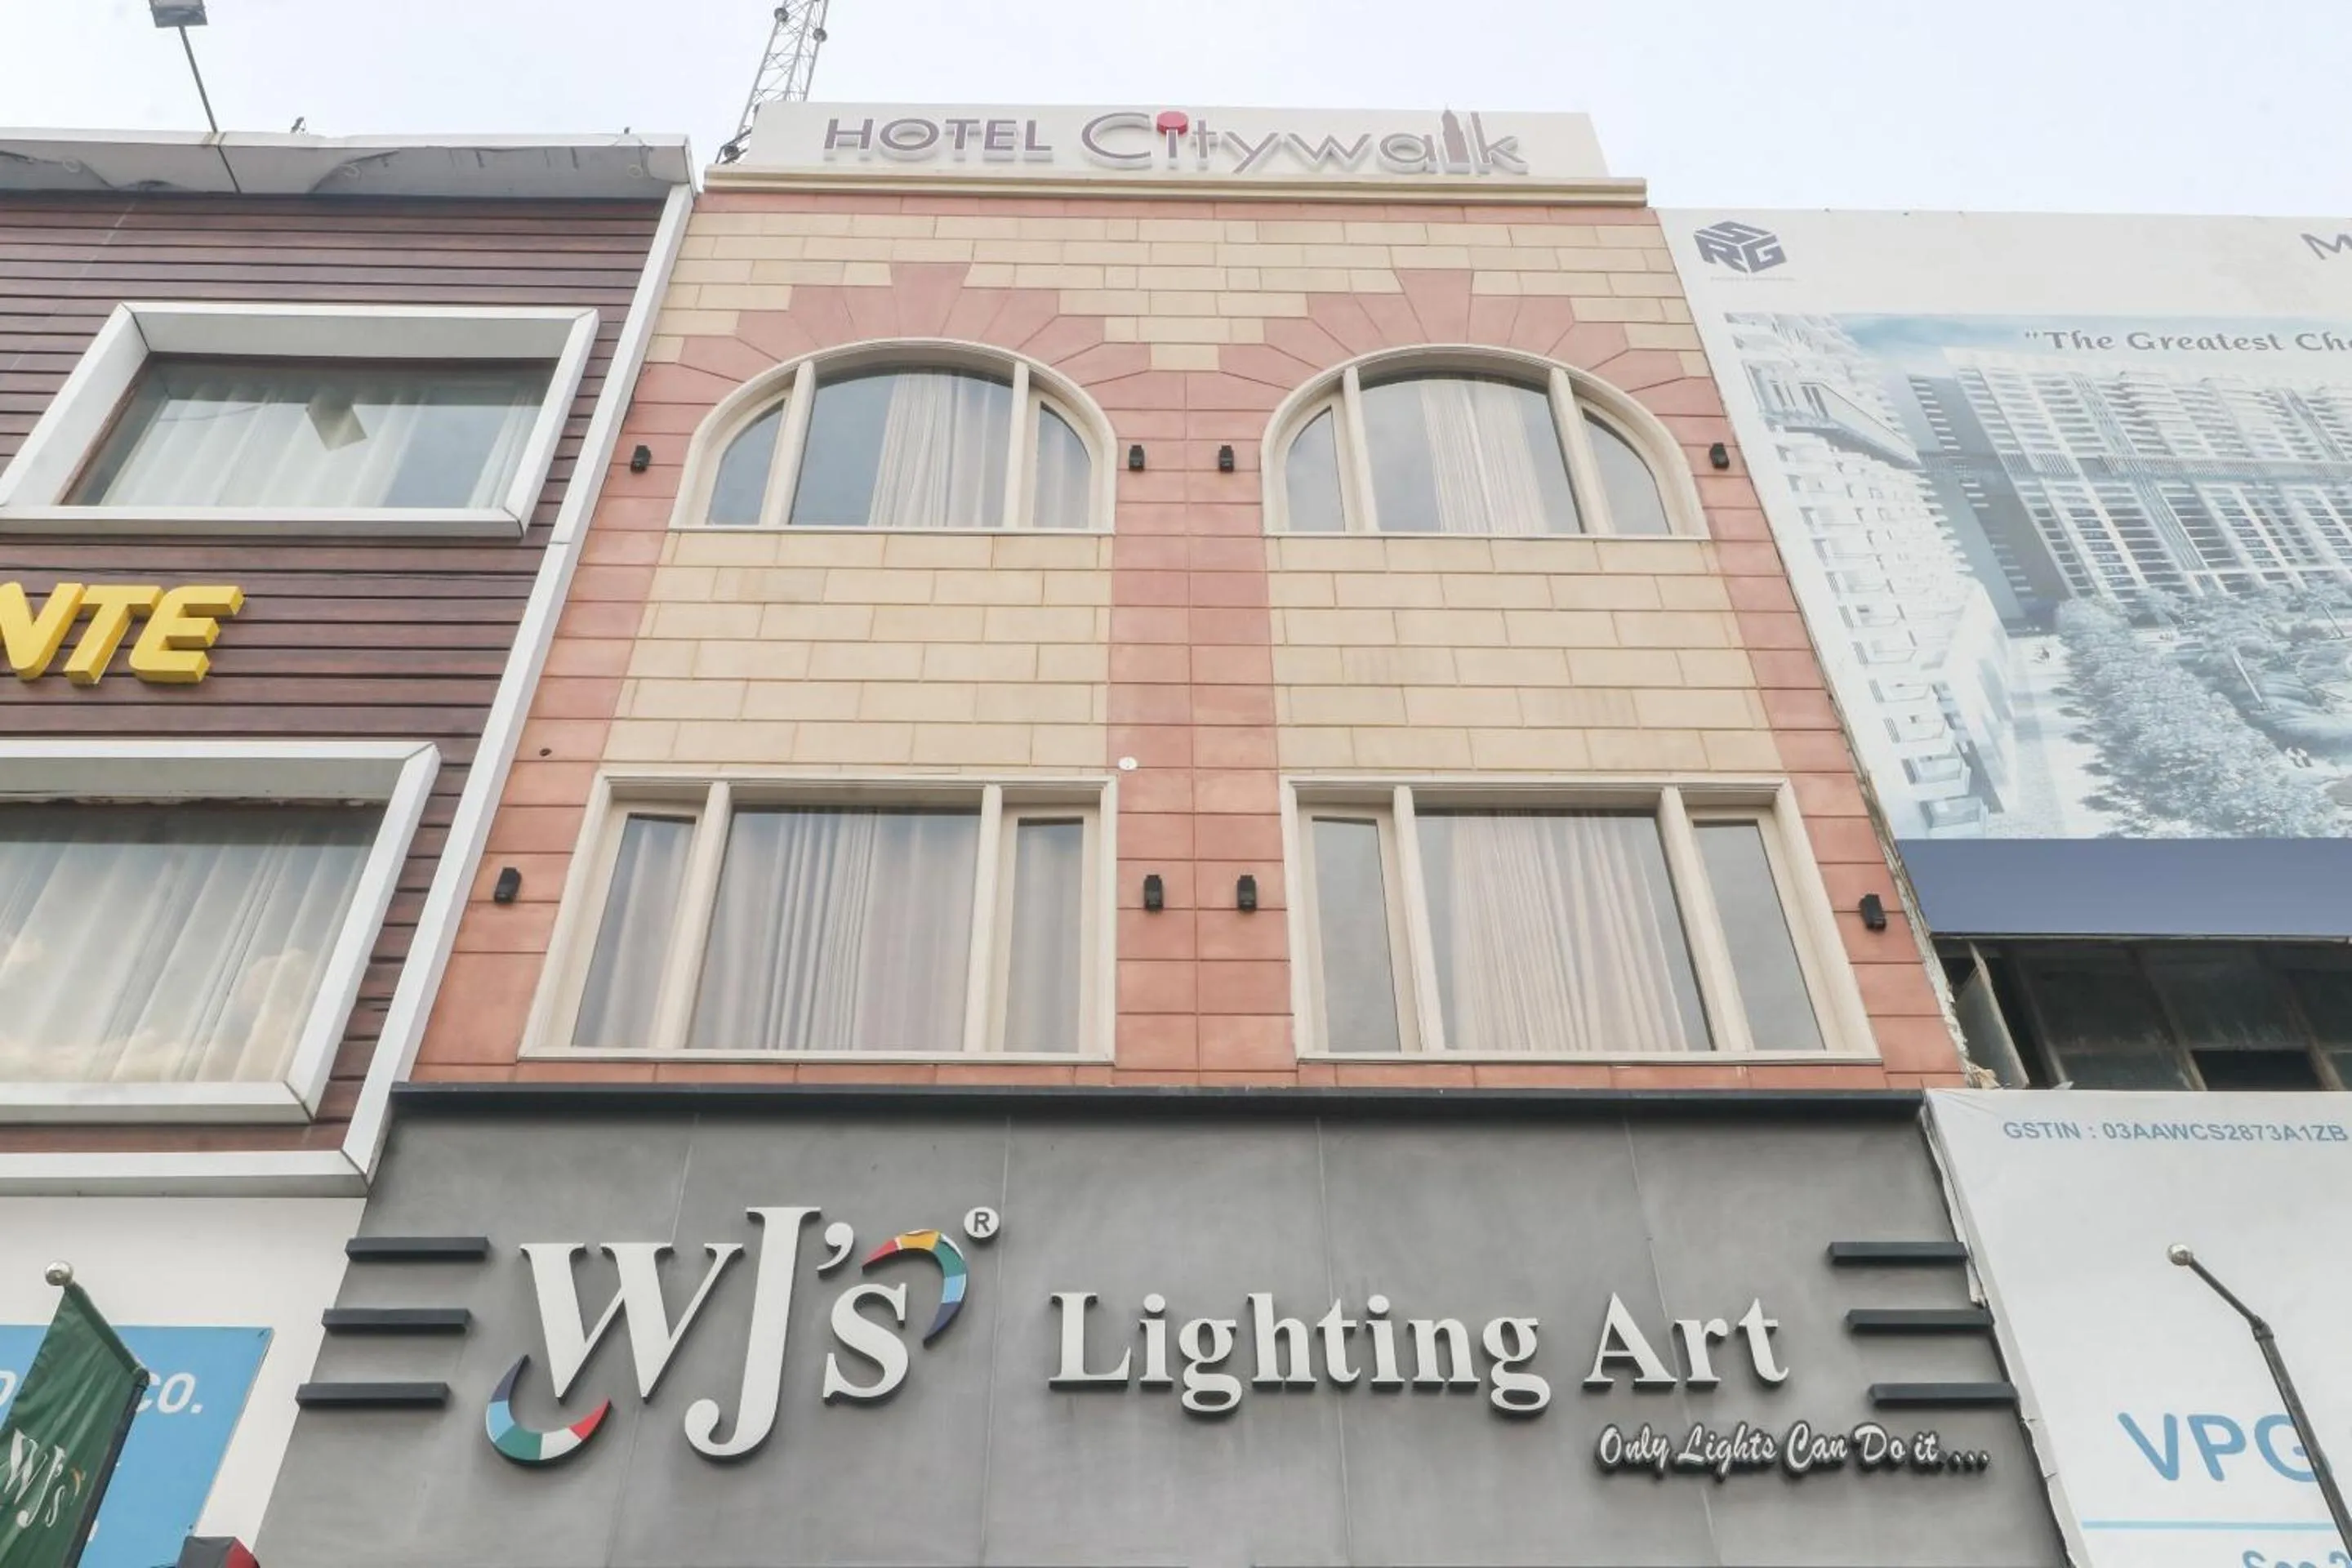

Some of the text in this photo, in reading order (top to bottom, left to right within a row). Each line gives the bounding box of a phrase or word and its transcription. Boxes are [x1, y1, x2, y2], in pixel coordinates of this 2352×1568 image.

[823, 104, 1529, 175] HOTEL Citywalk
[2127, 332, 2286, 351] Greatest
[2295, 331, 2352, 351] Ch
[2002, 1121, 2081, 1139] GSTIN
[1049, 1292, 1552, 1414] Lighting
[1582, 1291, 1789, 1386] Art
[1598, 1423, 1669, 1471] Only
[1677, 1422, 1777, 1477] Lights
[1786, 1421, 1848, 1471] Can
[1852, 1423, 1906, 1464] Do
